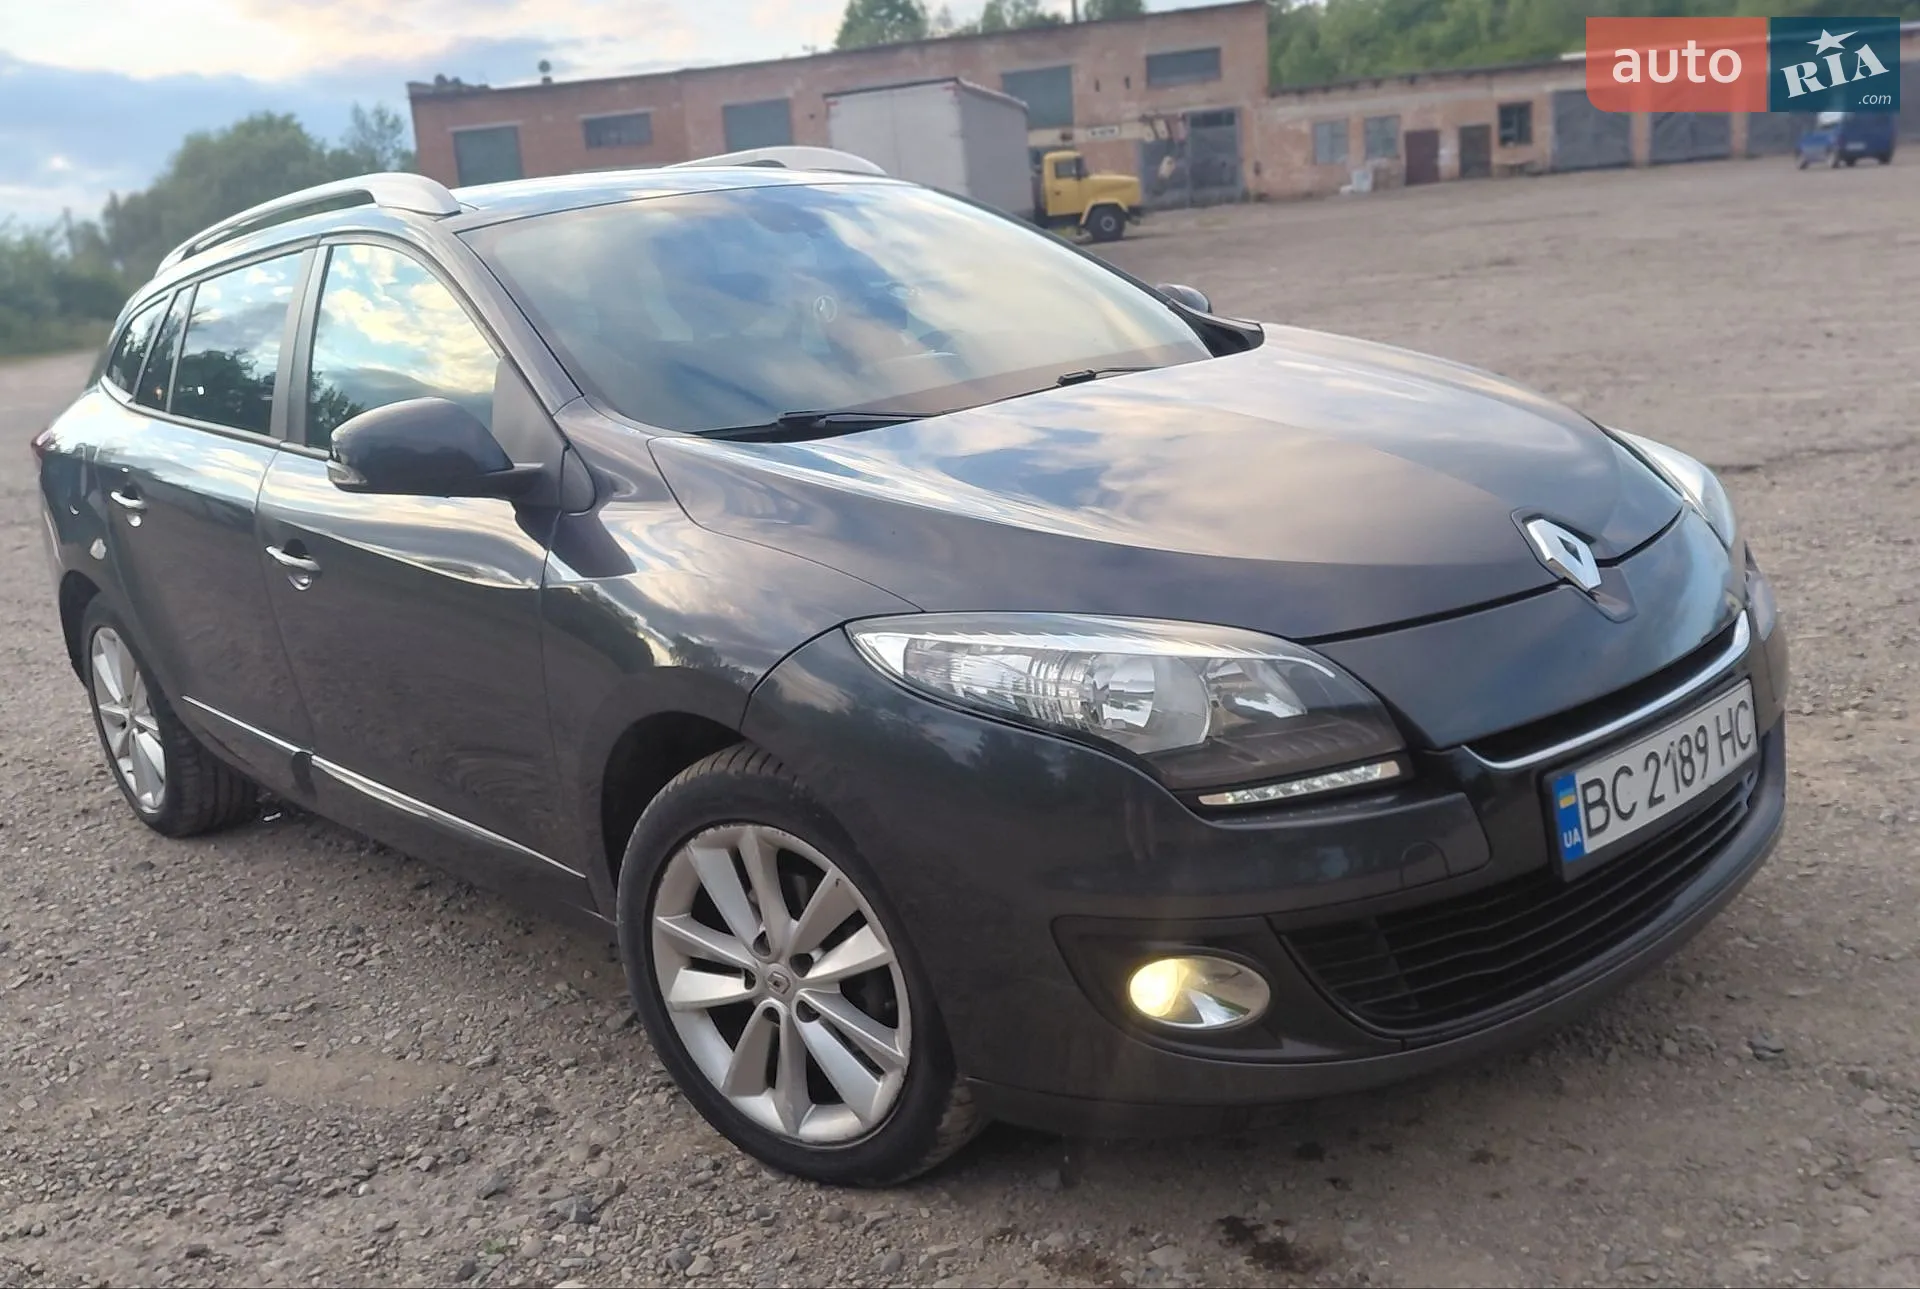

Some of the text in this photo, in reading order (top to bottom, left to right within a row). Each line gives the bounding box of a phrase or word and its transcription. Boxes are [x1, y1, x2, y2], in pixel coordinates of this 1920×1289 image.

[1581, 699, 1752, 838] BC 2189 HC
[1563, 828, 1581, 848] UA
